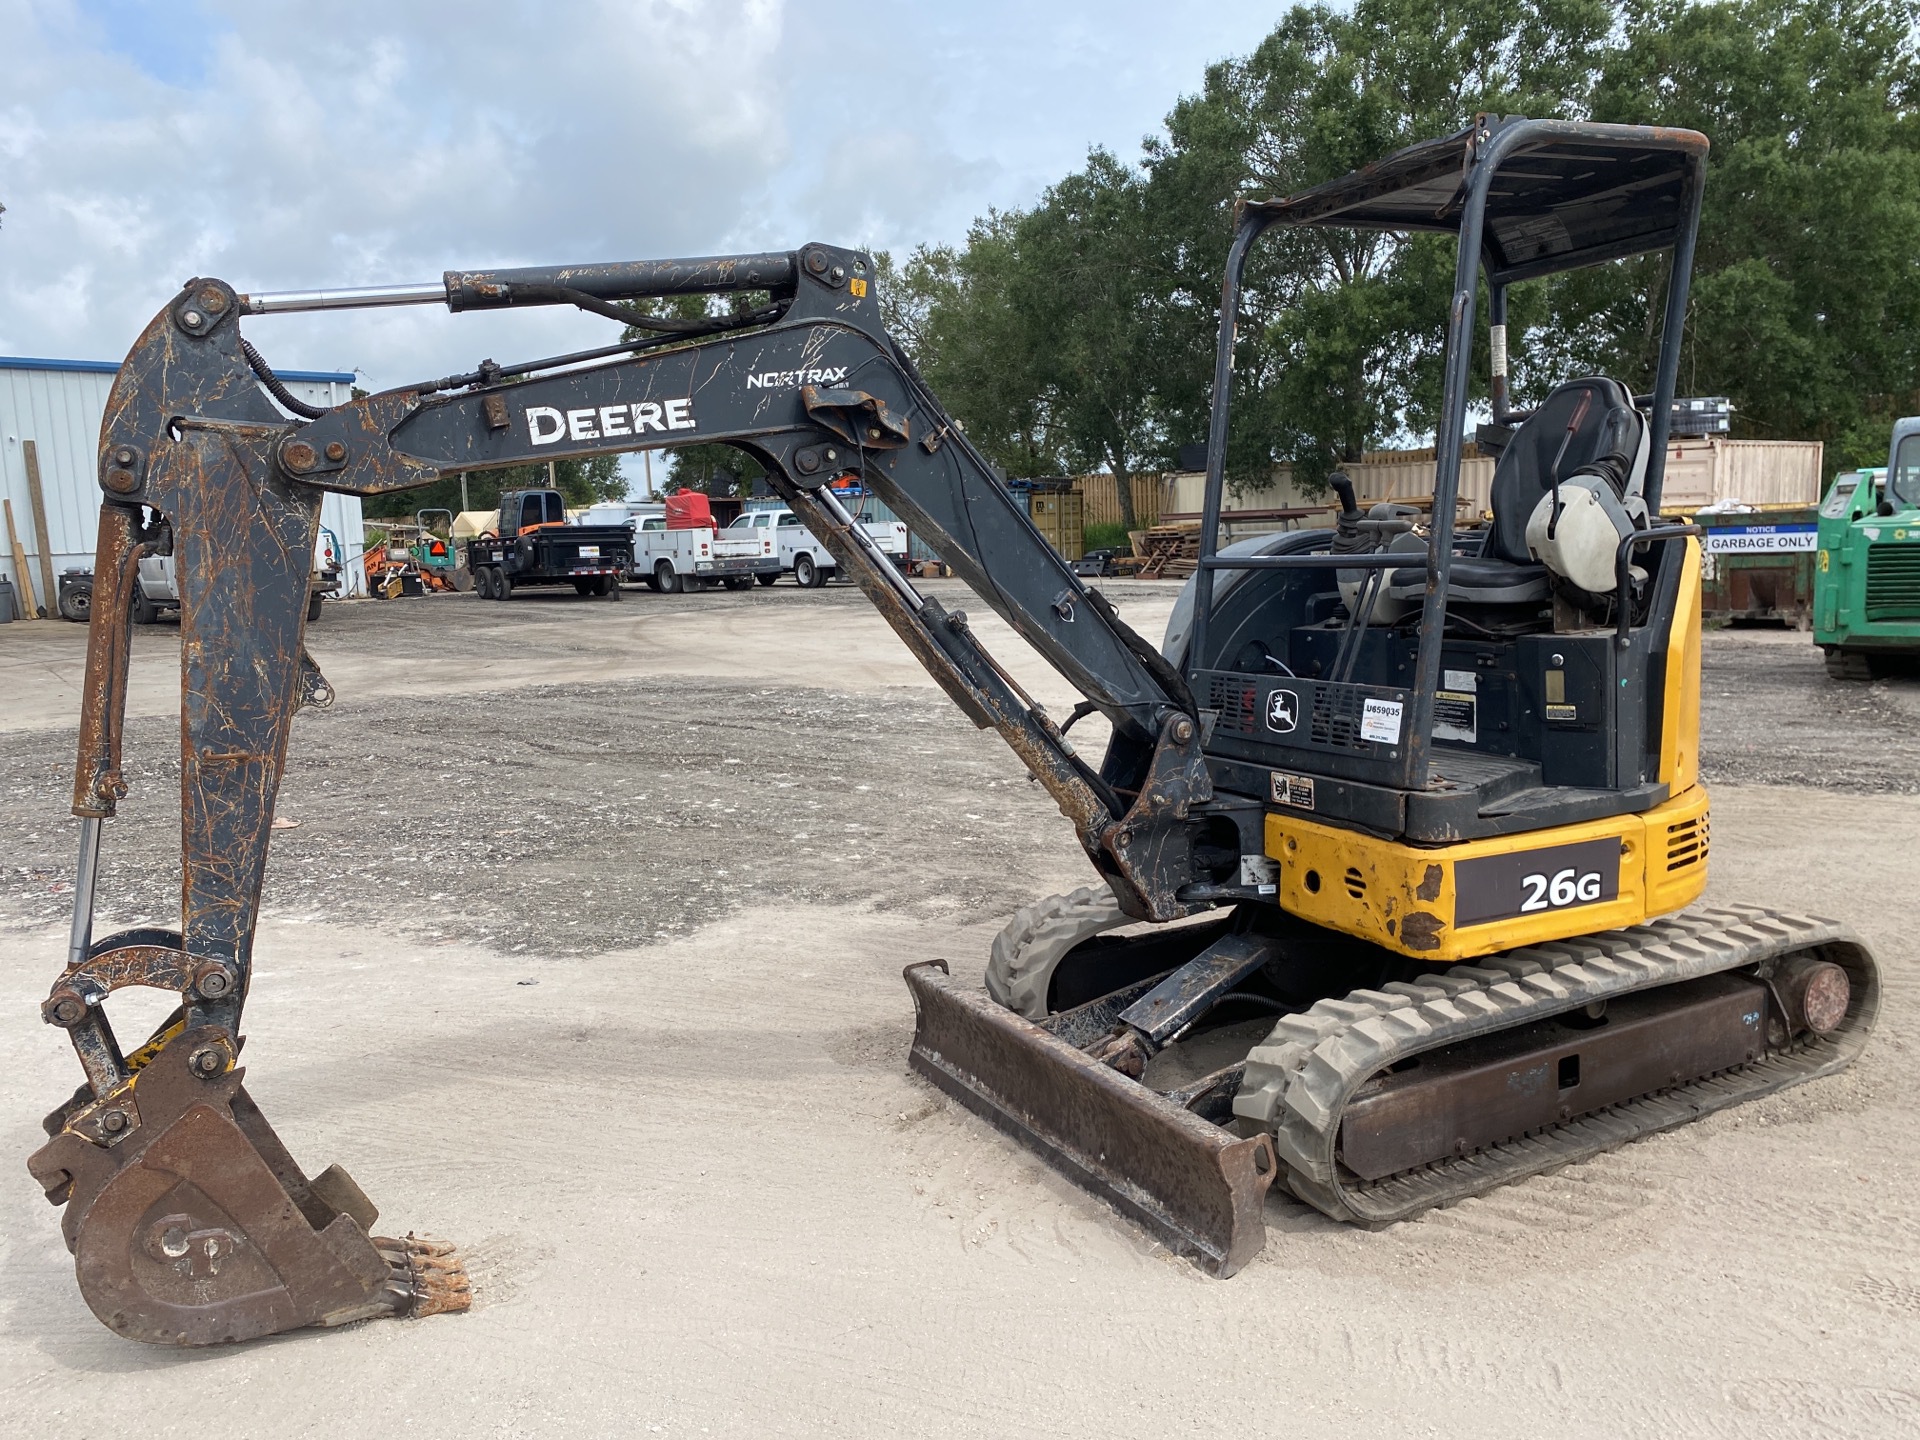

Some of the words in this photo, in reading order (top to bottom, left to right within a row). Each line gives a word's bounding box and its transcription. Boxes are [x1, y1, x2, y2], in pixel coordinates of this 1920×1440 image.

[746, 366, 848, 389] NORTRAX
[525, 397, 696, 446] DEERE
[1711, 537, 1774, 549] GARBAGE
[1778, 536, 1813, 547] ONLY
[1366, 704, 1400, 716] U659035
[1521, 868, 1601, 912] 26G
